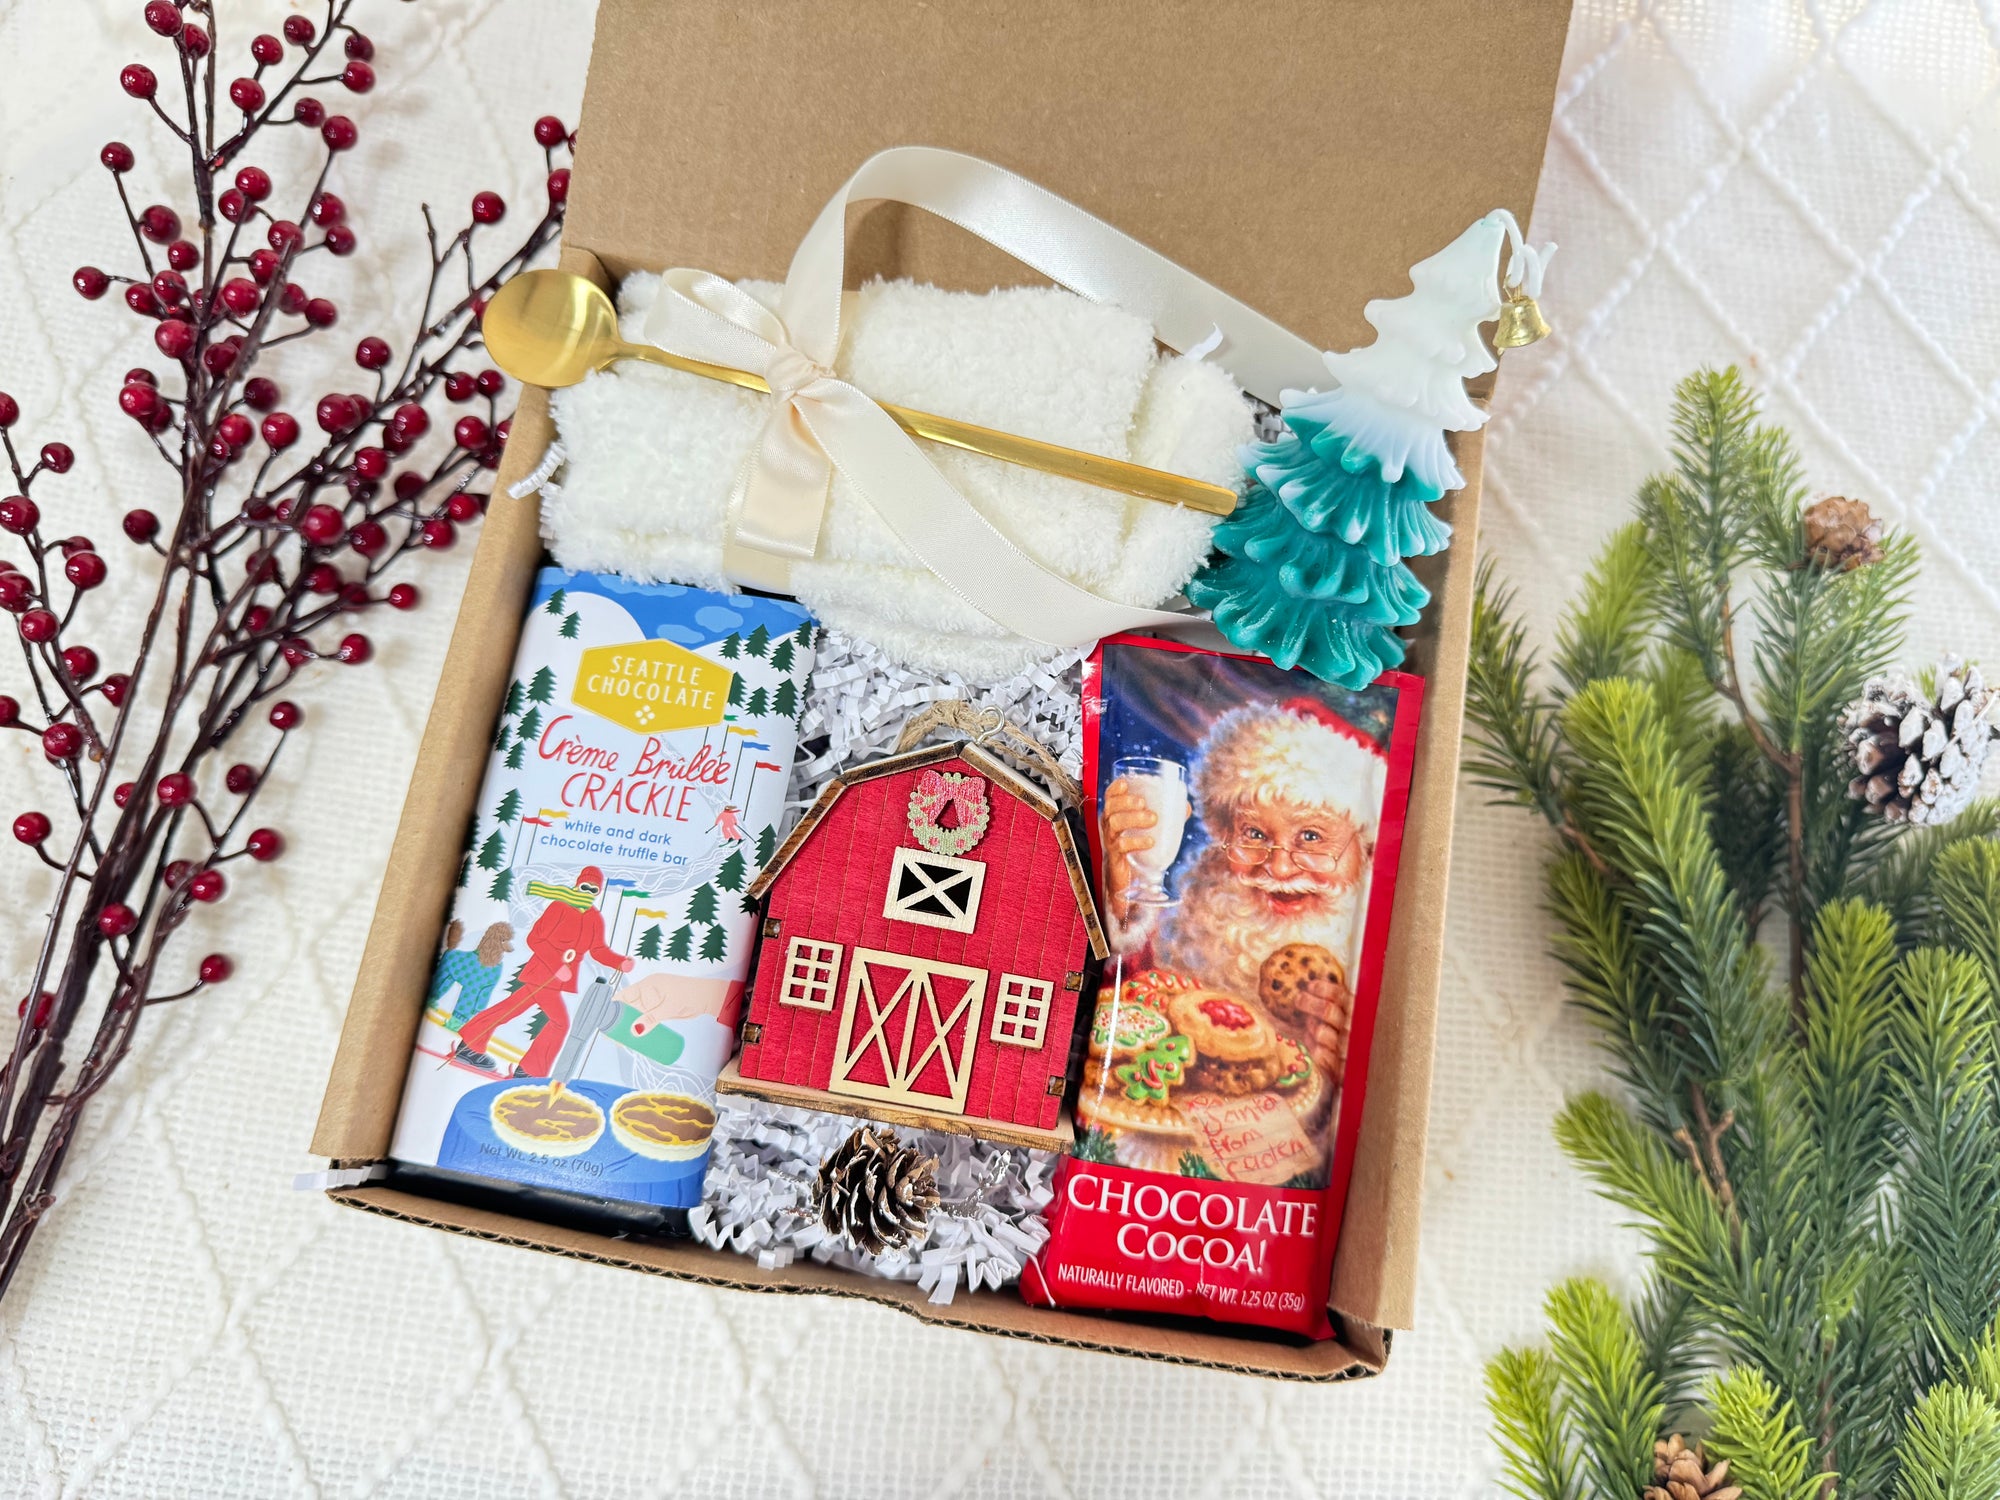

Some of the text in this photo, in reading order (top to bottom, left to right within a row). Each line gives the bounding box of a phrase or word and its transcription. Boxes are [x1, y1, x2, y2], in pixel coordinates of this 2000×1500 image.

[587, 674, 715, 710] CHOCOLATE
[610, 656, 702, 686] SEATTLE
[538, 715, 731, 785] Crème Brûlée
[560, 772, 697, 822] CRACKLE
[540, 835, 688, 865] chocolate truffle bar
[565, 820, 672, 845] white and dark
[529, 1152, 549, 1165] 2.5
[552, 1158, 567, 1168] oz
[571, 1158, 604, 1177] (70g)
[1067, 1173, 1317, 1238] CHOCOLATE
[1116, 1223, 1268, 1275] COCOA!
[1057, 1262, 1124, 1290] NATURALLY
[1125, 1274, 1184, 1297] FLAVORED
[1195, 1281, 1219, 1300] NET
[1219, 1287, 1238, 1305] WT.
[1240, 1289, 1261, 1307] 1.25
[1262, 1291, 1277, 1308] OZ
[1278, 1291, 1305, 1312] (35g)
